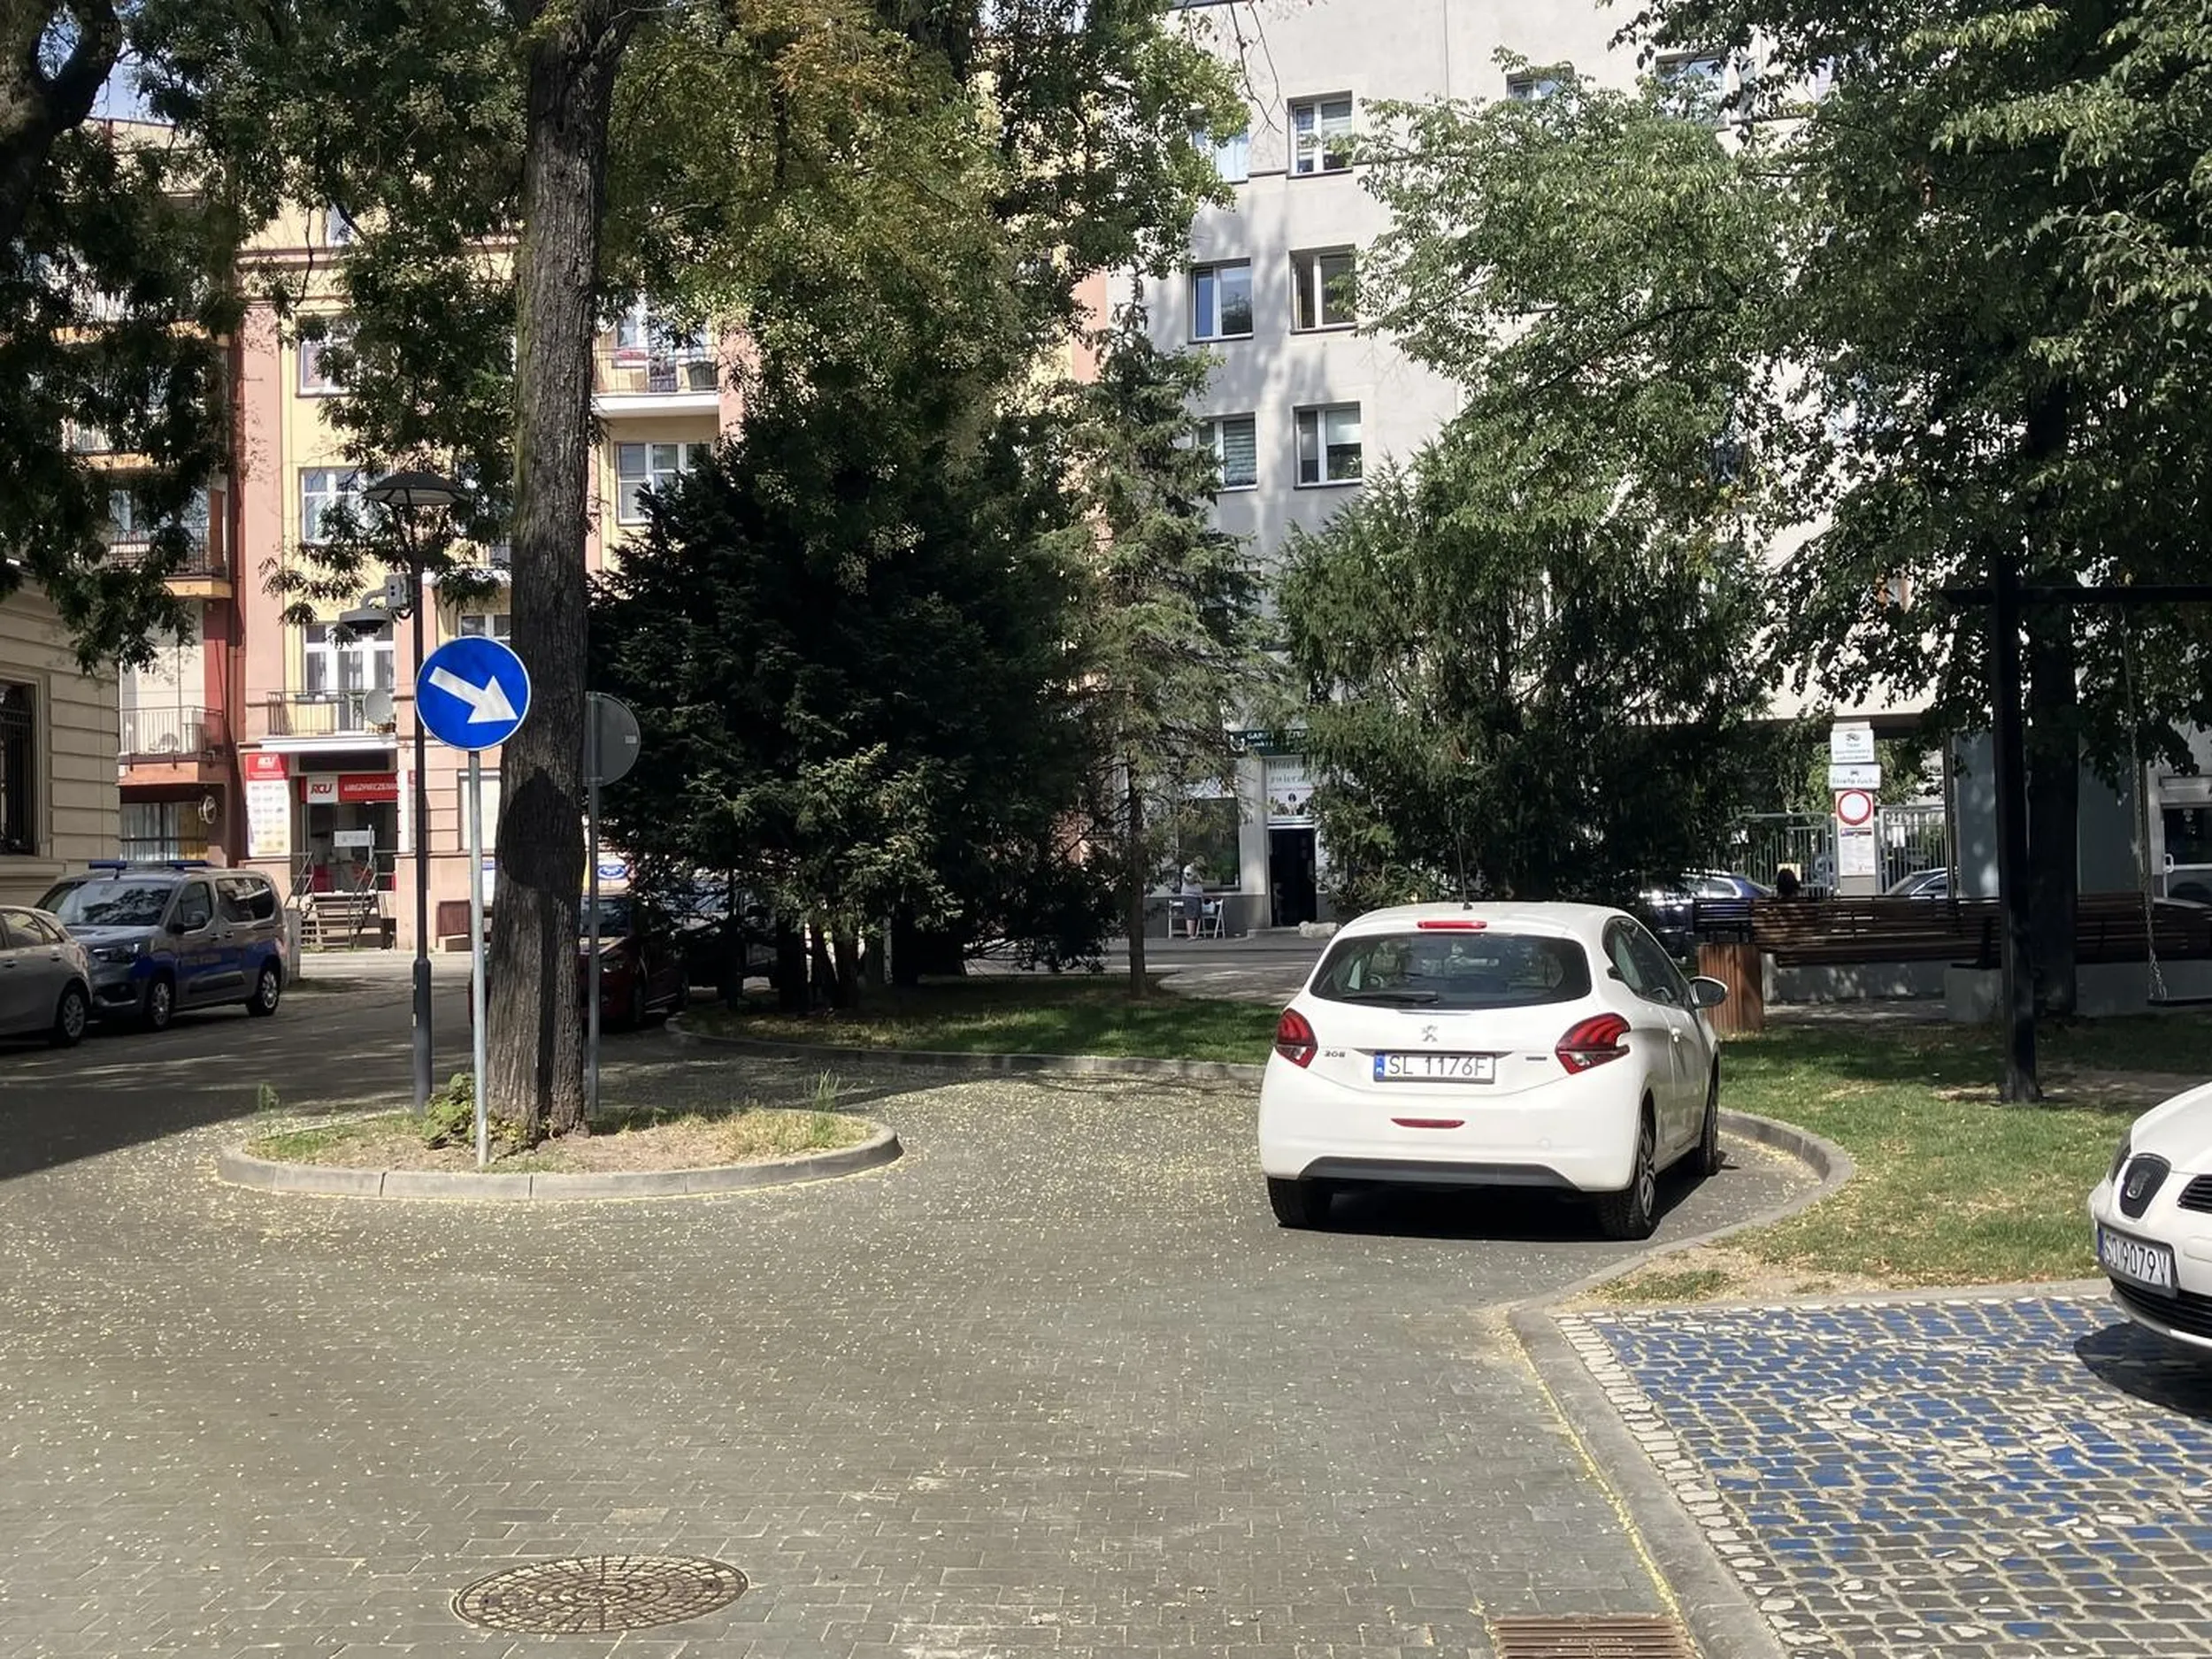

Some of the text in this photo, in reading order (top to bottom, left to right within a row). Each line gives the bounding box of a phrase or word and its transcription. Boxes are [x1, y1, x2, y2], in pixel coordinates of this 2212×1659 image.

[311, 783, 332, 795] RCU
[1389, 1055, 1489, 1077] SL 1176F
